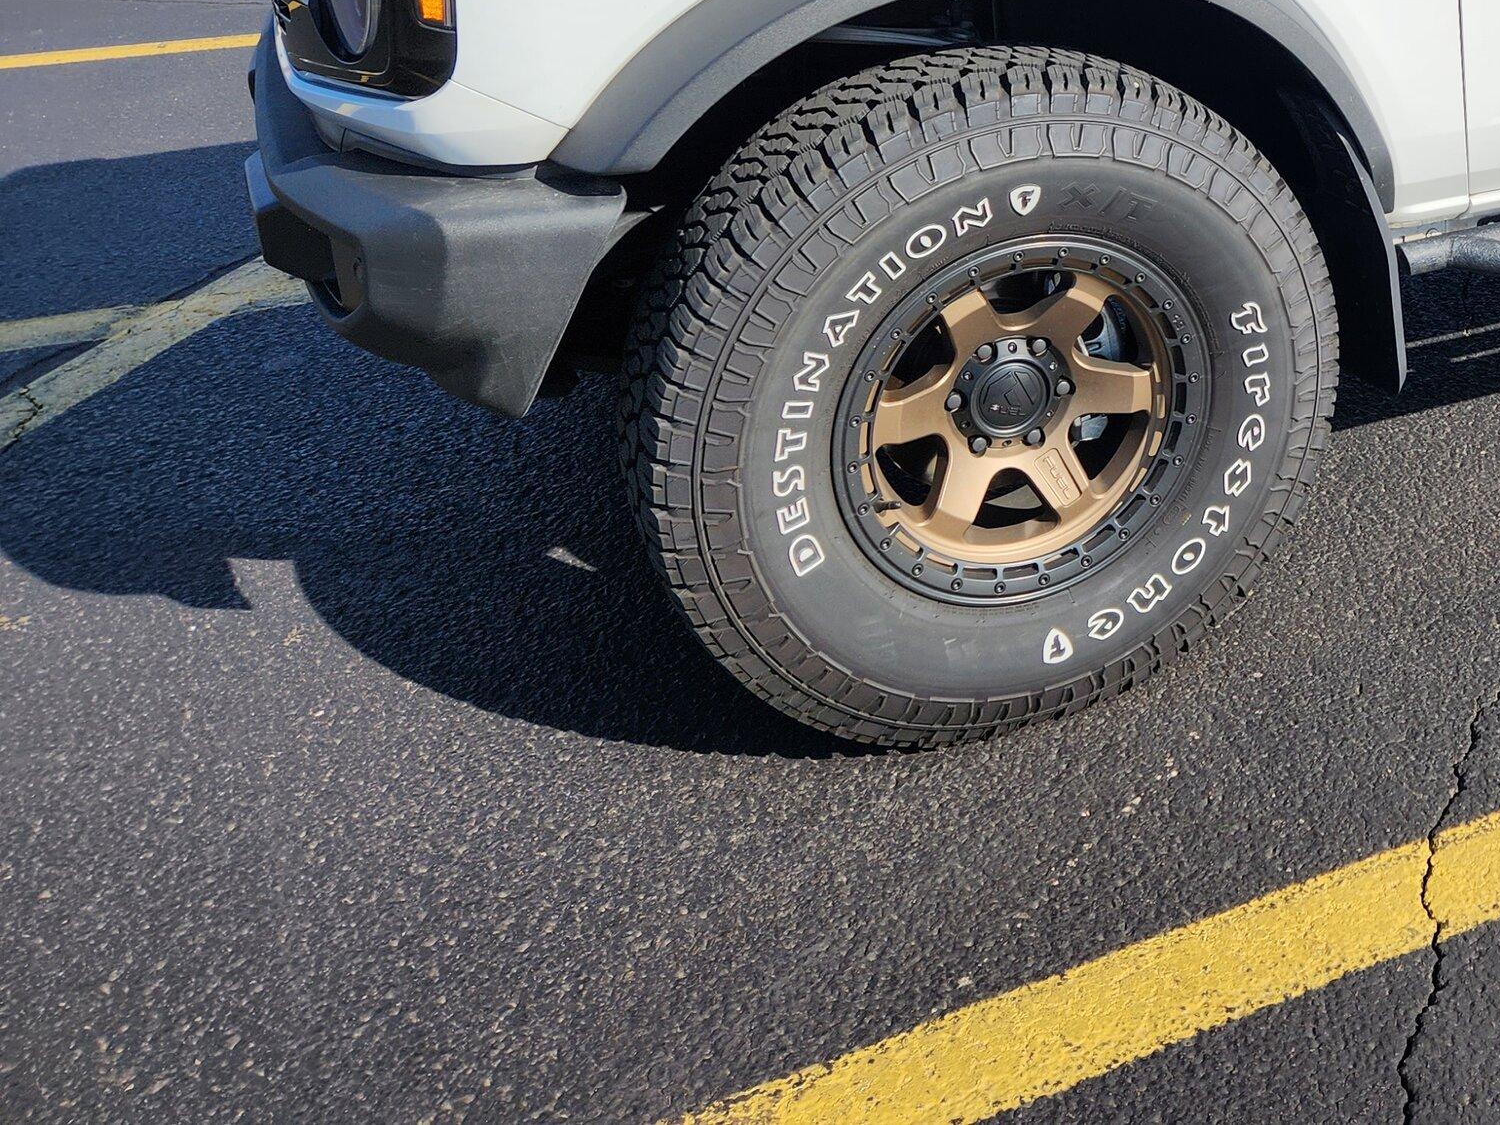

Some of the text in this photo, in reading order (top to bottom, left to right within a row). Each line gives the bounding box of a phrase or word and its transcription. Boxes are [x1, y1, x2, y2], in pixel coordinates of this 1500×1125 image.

[772, 197, 994, 577] DESTINATION
[1042, 456, 1071, 500] FUEL
[1086, 301, 1271, 641] Firestone
